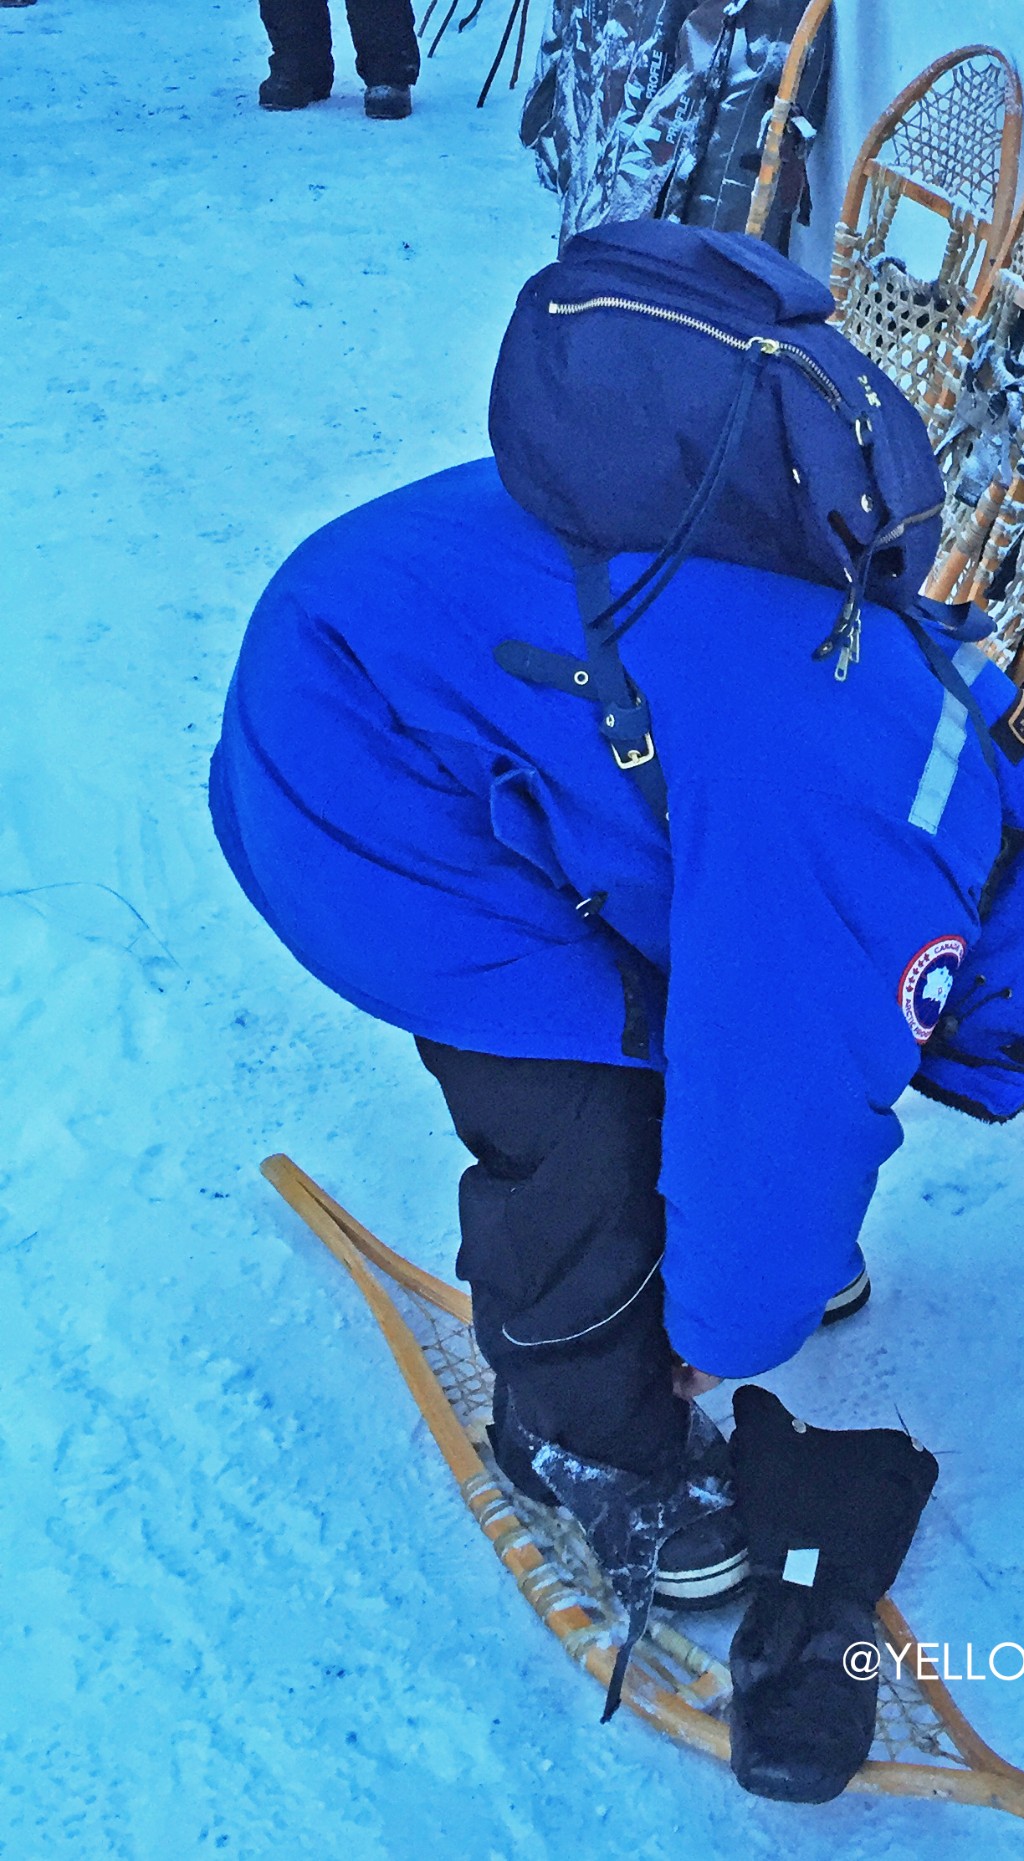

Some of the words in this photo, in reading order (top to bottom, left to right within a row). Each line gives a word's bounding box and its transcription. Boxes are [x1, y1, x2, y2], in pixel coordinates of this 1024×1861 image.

[645, 49, 663, 99] PROFILE
[665, 94, 691, 145] PROFILE
[904, 998, 917, 1029] ARCTIC
